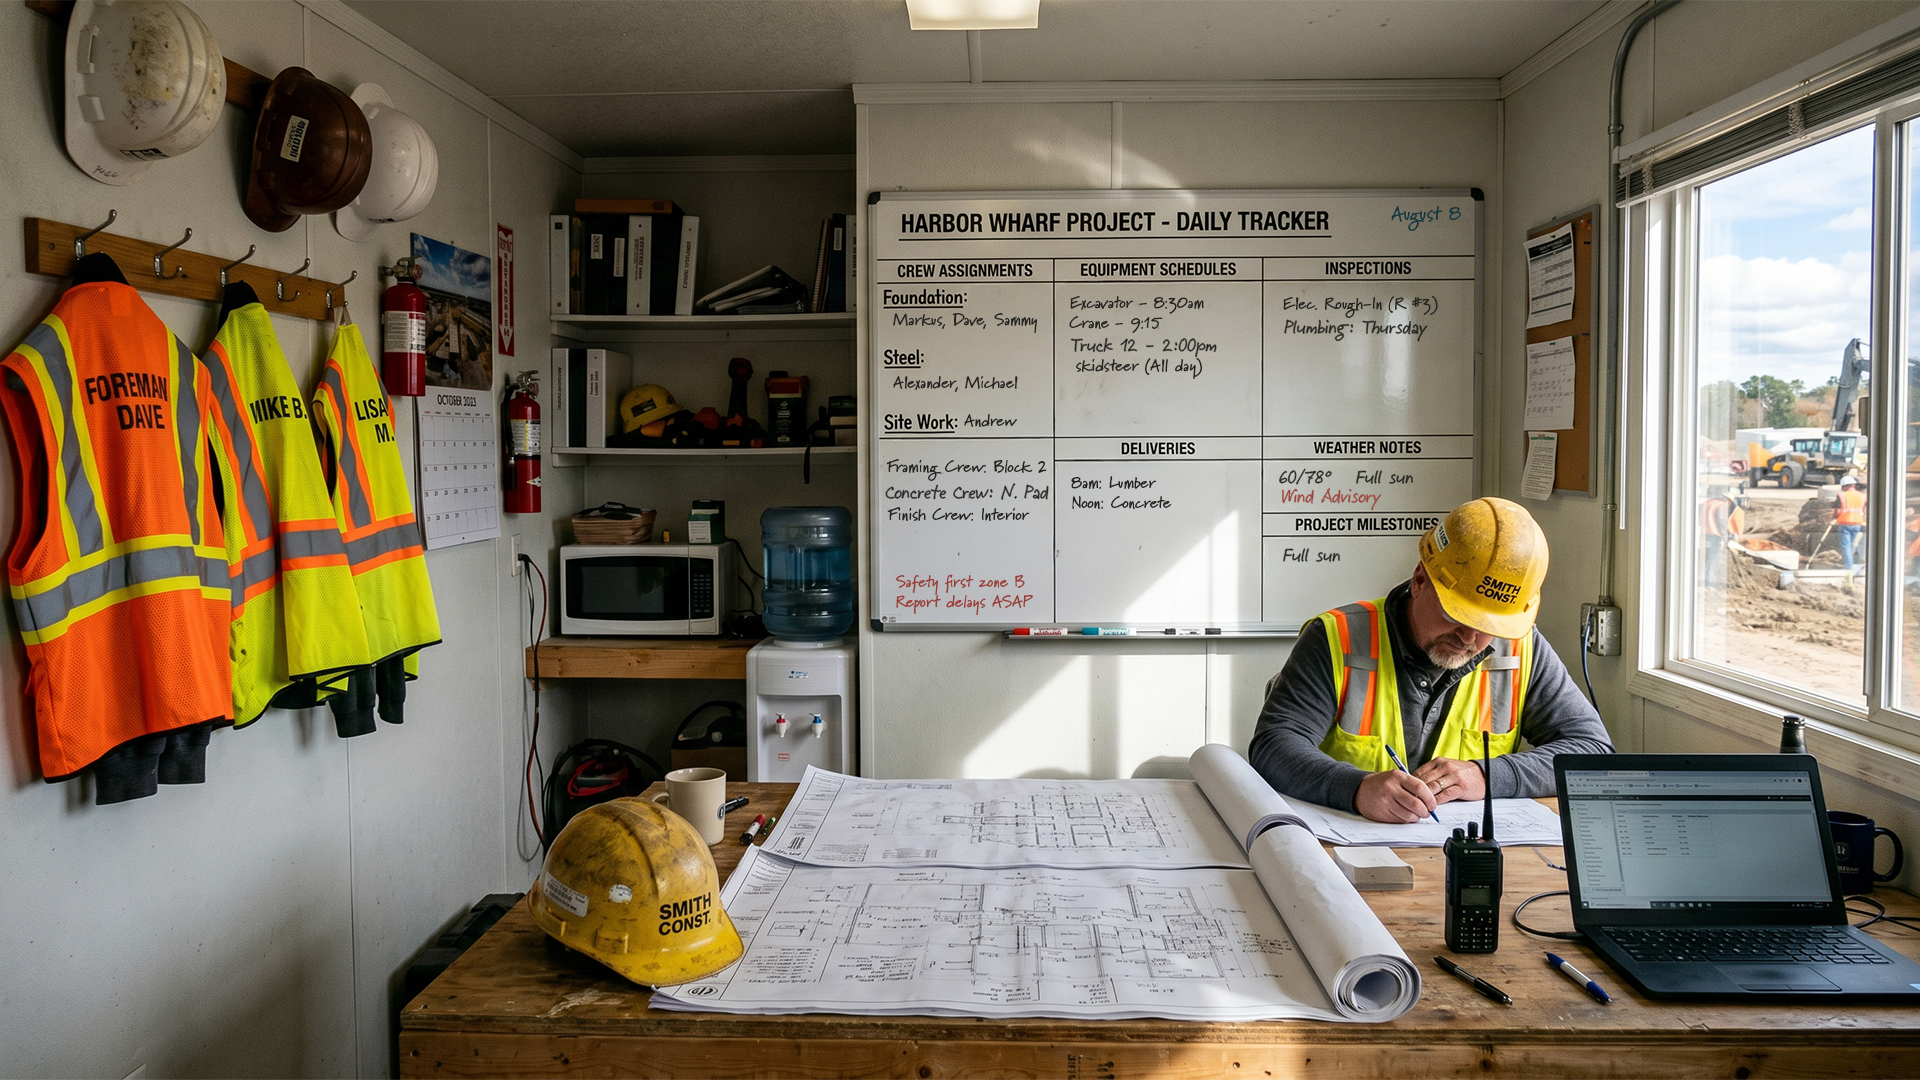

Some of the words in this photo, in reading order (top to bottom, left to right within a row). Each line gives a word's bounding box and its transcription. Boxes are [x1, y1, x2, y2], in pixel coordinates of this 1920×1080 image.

[902, 213, 982, 233] HARBOR
[989, 213, 1060, 232] WHARF
[1067, 212, 1155, 231] PROJECT
[1177, 212, 1232, 230] DAILY
[1238, 211, 1328, 230] TRACKER
[1391, 206, 1442, 231] August
[1449, 207, 1461, 220] 8
[898, 265, 935, 277] CREW
[939, 264, 1032, 277] ASSIGNMENTS
[1081, 263, 1156, 277] EQUIPMENT
[1160, 262, 1236, 276] SCHEDULES
[1326, 262, 1411, 274] INSPECTIONS
[884, 289, 967, 305] Foundation:
[1071, 296, 1133, 310] Excavator
[1154, 297, 1204, 314] 8:30am
[1284, 297, 1317, 310] Elec.
[1325, 297, 1382, 318] Rough-In
[1388, 296, 1407, 313] (R
[1412, 296, 1438, 315] #3)
[893, 313, 945, 329] Markus,
[953, 313, 986, 329] Dave,
[994, 313, 1037, 333] Sammy
[1069, 316, 1109, 329] Crane
[1131, 317, 1162, 333] 9:15
[1284, 319, 1353, 341] Plumbing:
[1362, 321, 1427, 341] Thursday
[884, 349, 924, 365] Steel:
[1071, 338, 1113, 352] Truck
[1120, 339, 1137, 351] 12
[1163, 338, 1216, 357] 2:00pm
[1076, 359, 1139, 372] skidsteer
[1145, 358, 1168, 375] (All
[1175, 358, 1202, 379] day)
[85, 372, 168, 405] FOREMAN
[893, 376, 958, 392] Alexander,
[965, 376, 1017, 389] Michael
[116, 404, 165, 430] DAVE
[292, 397, 308, 419] B.
[355, 398, 389, 421] LISA
[884, 414, 912, 430] Site
[917, 414, 957, 429] Work:
[964, 414, 1017, 427] Andrew
[375, 423, 395, 443] M.
[1122, 442, 1195, 454] DELIVERIES
[1314, 442, 1375, 453] WEATHER
[1380, 441, 1421, 453] NOTES
[887, 459, 941, 481] Framing
[945, 460, 986, 472] Crew:
[994, 460, 1032, 473] Block
[1038, 461, 1046, 473] 2
[1356, 470, 1382, 484] Full
[1389, 474, 1413, 484] sun
[886, 484, 946, 499] Concrete
[953, 487, 993, 499] Crew:
[1001, 483, 1017, 500] N.
[1024, 484, 1049, 500] Pad
[1071, 477, 1101, 489] 8am:
[1110, 476, 1156, 489] Lumber
[1072, 496, 1103, 509] Noon:
[1111, 496, 1171, 509] Concrete
[1282, 489, 1314, 503] Wind
[1321, 488, 1381, 510] Advisory
[888, 507, 926, 521] Finish
[932, 508, 973, 521] Crew:
[982, 508, 1029, 521] Interior
[1296, 518, 1353, 530] PROJECT
[1358, 518, 1439, 531] MILESTONES
[1283, 548, 1309, 562] Full
[1316, 552, 1340, 562] sun
[896, 575, 938, 596] Safety
[945, 575, 973, 593] first
[979, 580, 1008, 588] zone
[1015, 575, 1025, 588] B
[1475, 584, 1518, 604] CONST.
[1482, 575, 1522, 595] SMITH
[896, 595, 941, 614] Report
[946, 595, 985, 615] delays
[992, 595, 1033, 608] ASAP
[659, 891, 711, 920] SMITH
[658, 910, 711, 936] CONST.
